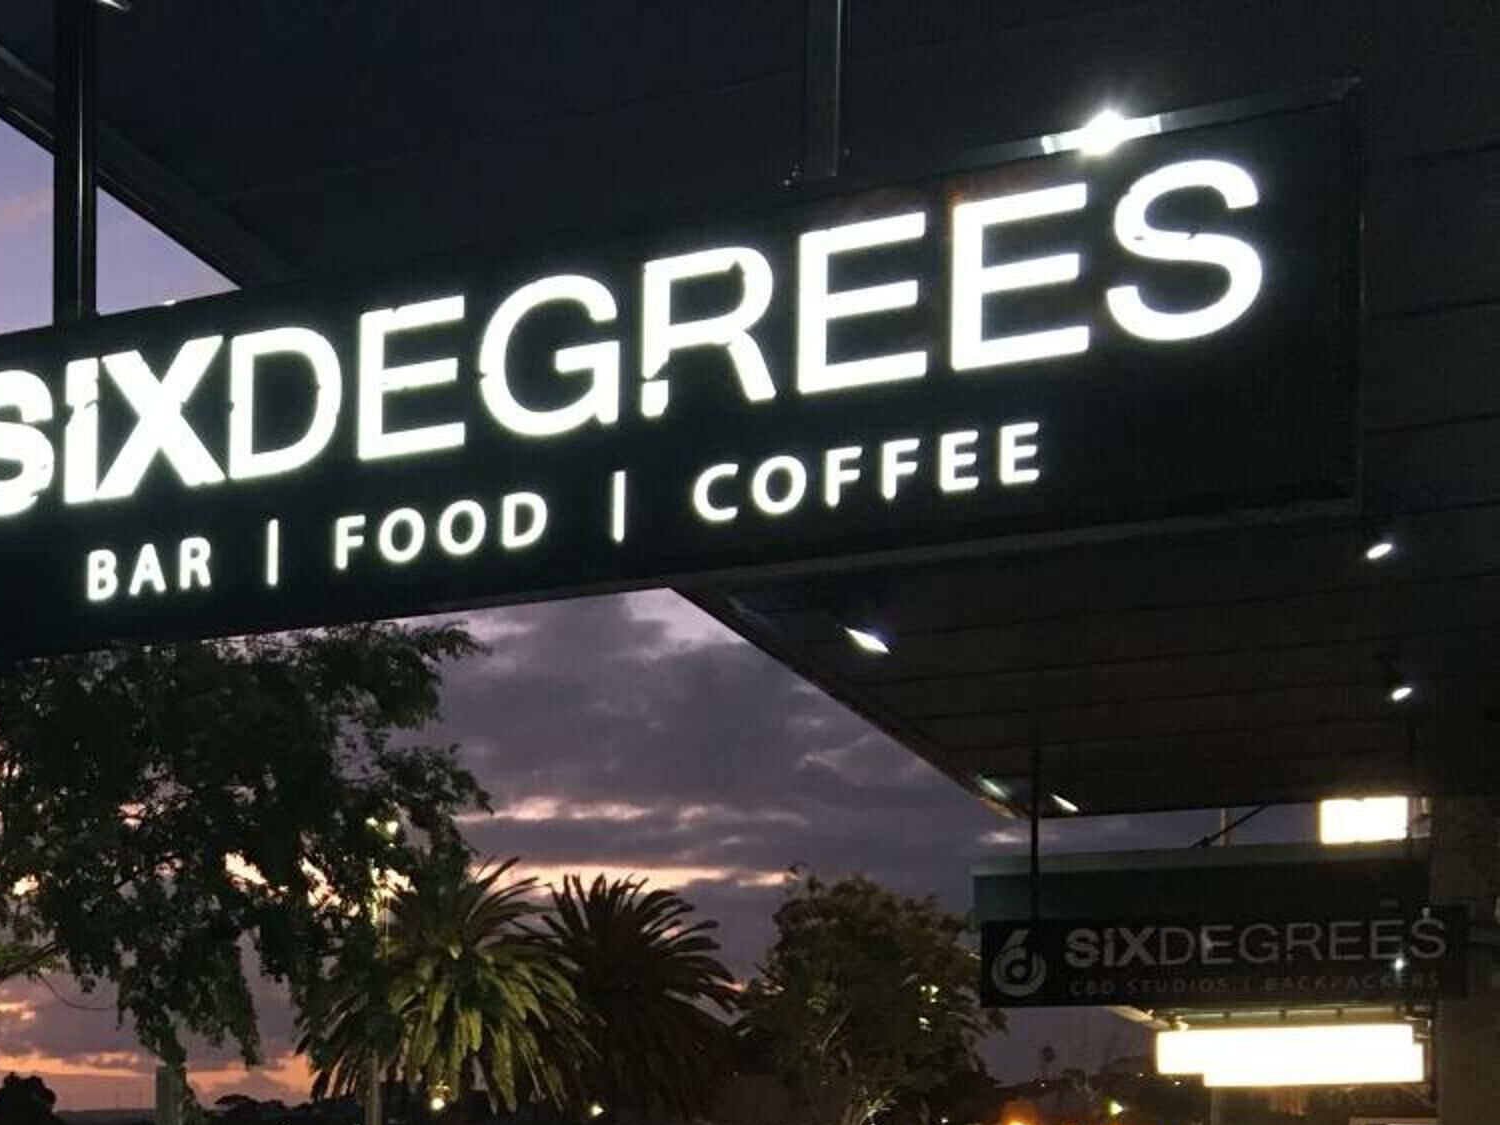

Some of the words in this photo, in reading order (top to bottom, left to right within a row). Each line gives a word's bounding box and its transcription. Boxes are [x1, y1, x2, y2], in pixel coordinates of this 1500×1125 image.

[85, 536, 212, 603] BAR
[333, 490, 549, 571] FOOD
[692, 421, 1041, 523] COFFEE
[1124, 976, 1230, 995] STUDIOS
[1263, 970, 1442, 992] BACKPACKERS
